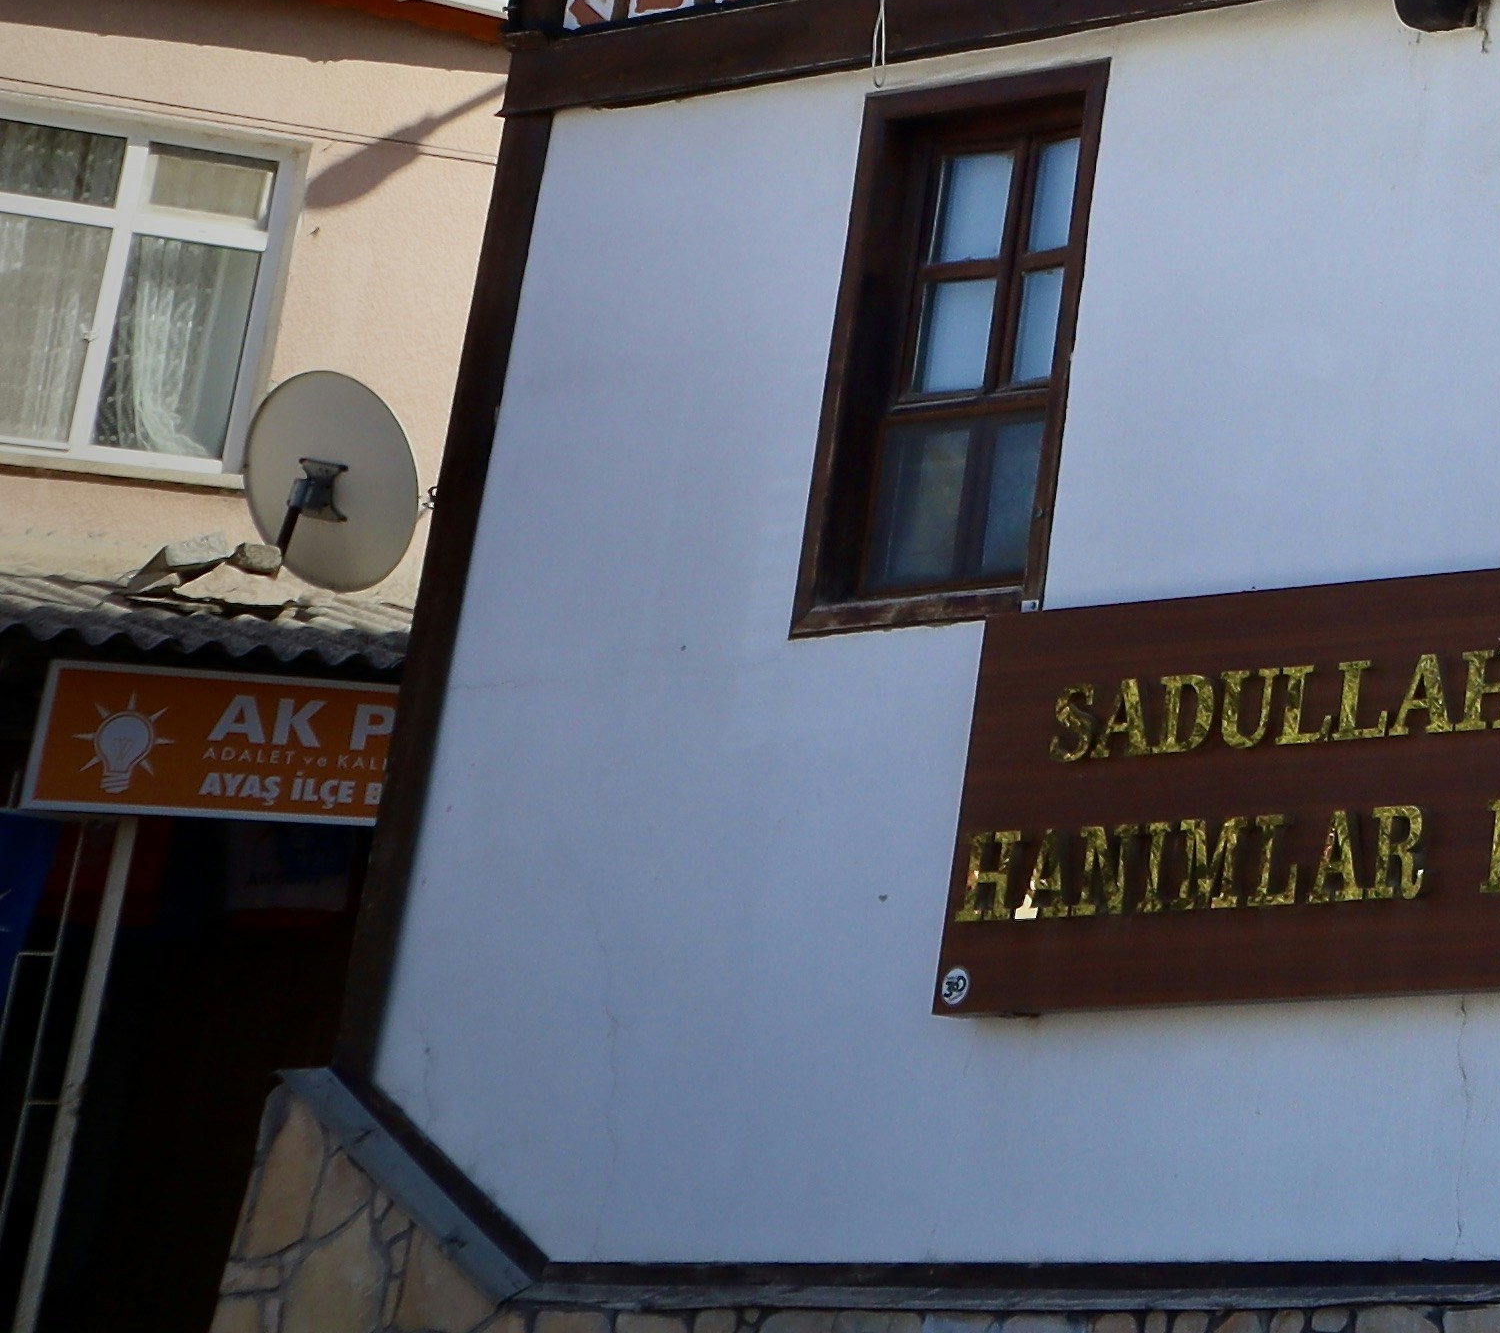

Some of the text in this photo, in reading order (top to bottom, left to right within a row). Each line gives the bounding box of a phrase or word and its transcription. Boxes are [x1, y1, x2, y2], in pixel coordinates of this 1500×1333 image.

[207, 694, 327, 747] AK
[203, 747, 296, 765] ADALET
[199, 772, 281, 806] AYAŞ
[290, 770, 356, 809] İLÇE
[954, 804, 1425, 922] HANIMLAR
